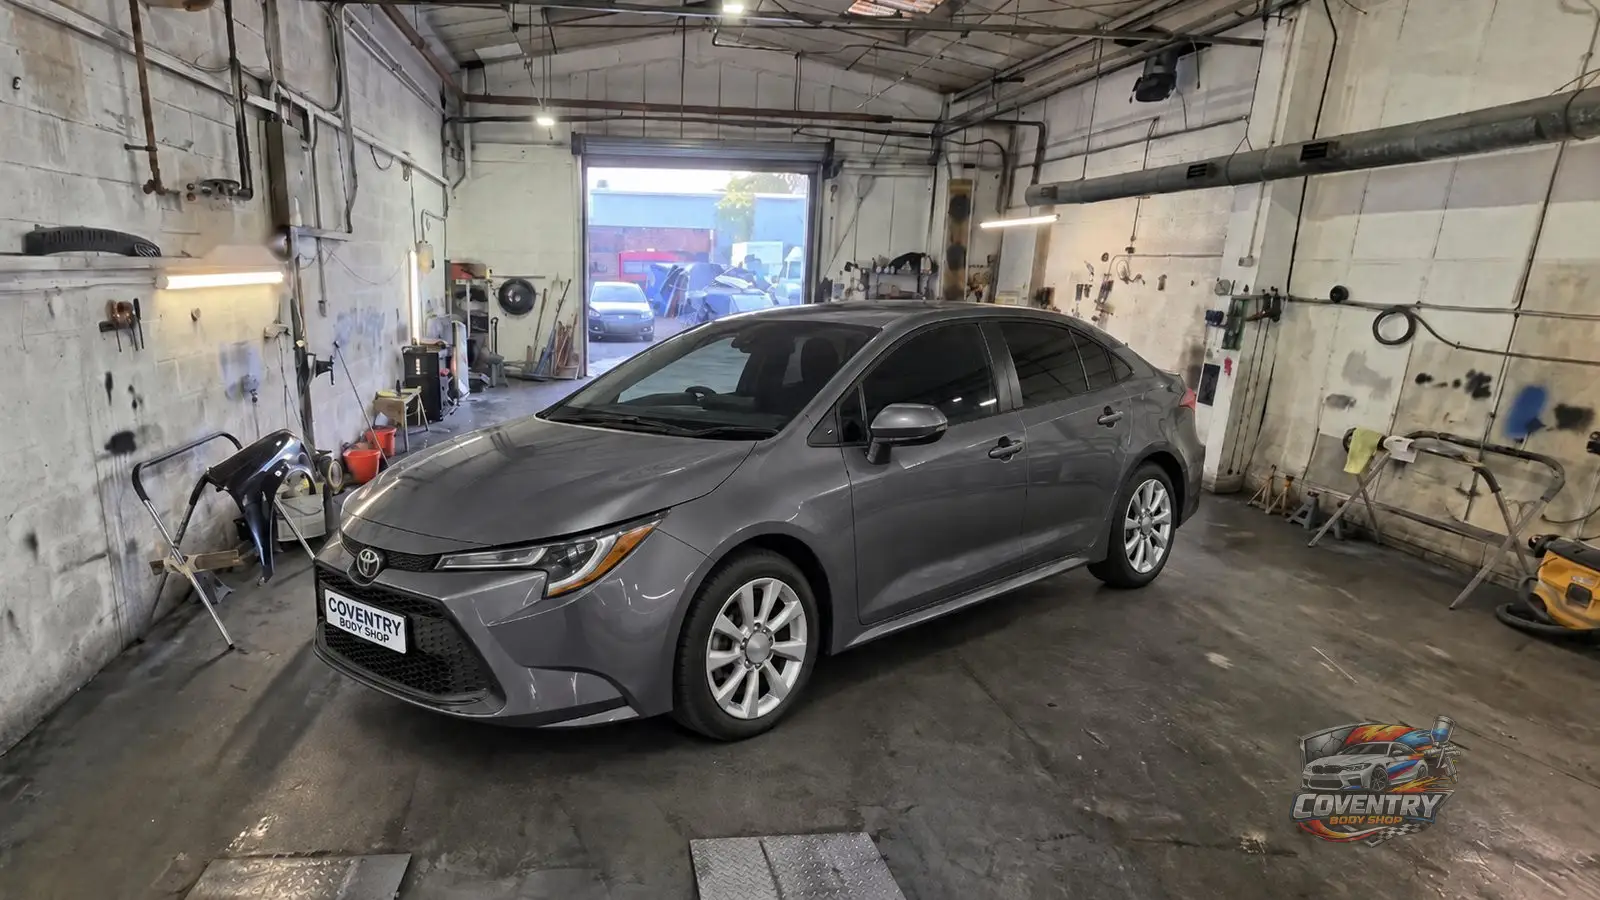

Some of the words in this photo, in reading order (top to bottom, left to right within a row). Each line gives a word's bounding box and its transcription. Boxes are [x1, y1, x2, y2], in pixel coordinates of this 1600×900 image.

[328, 597, 401, 637] COVENTRY
[339, 617, 363, 634] BODY
[364, 626, 390, 643] SHOP
